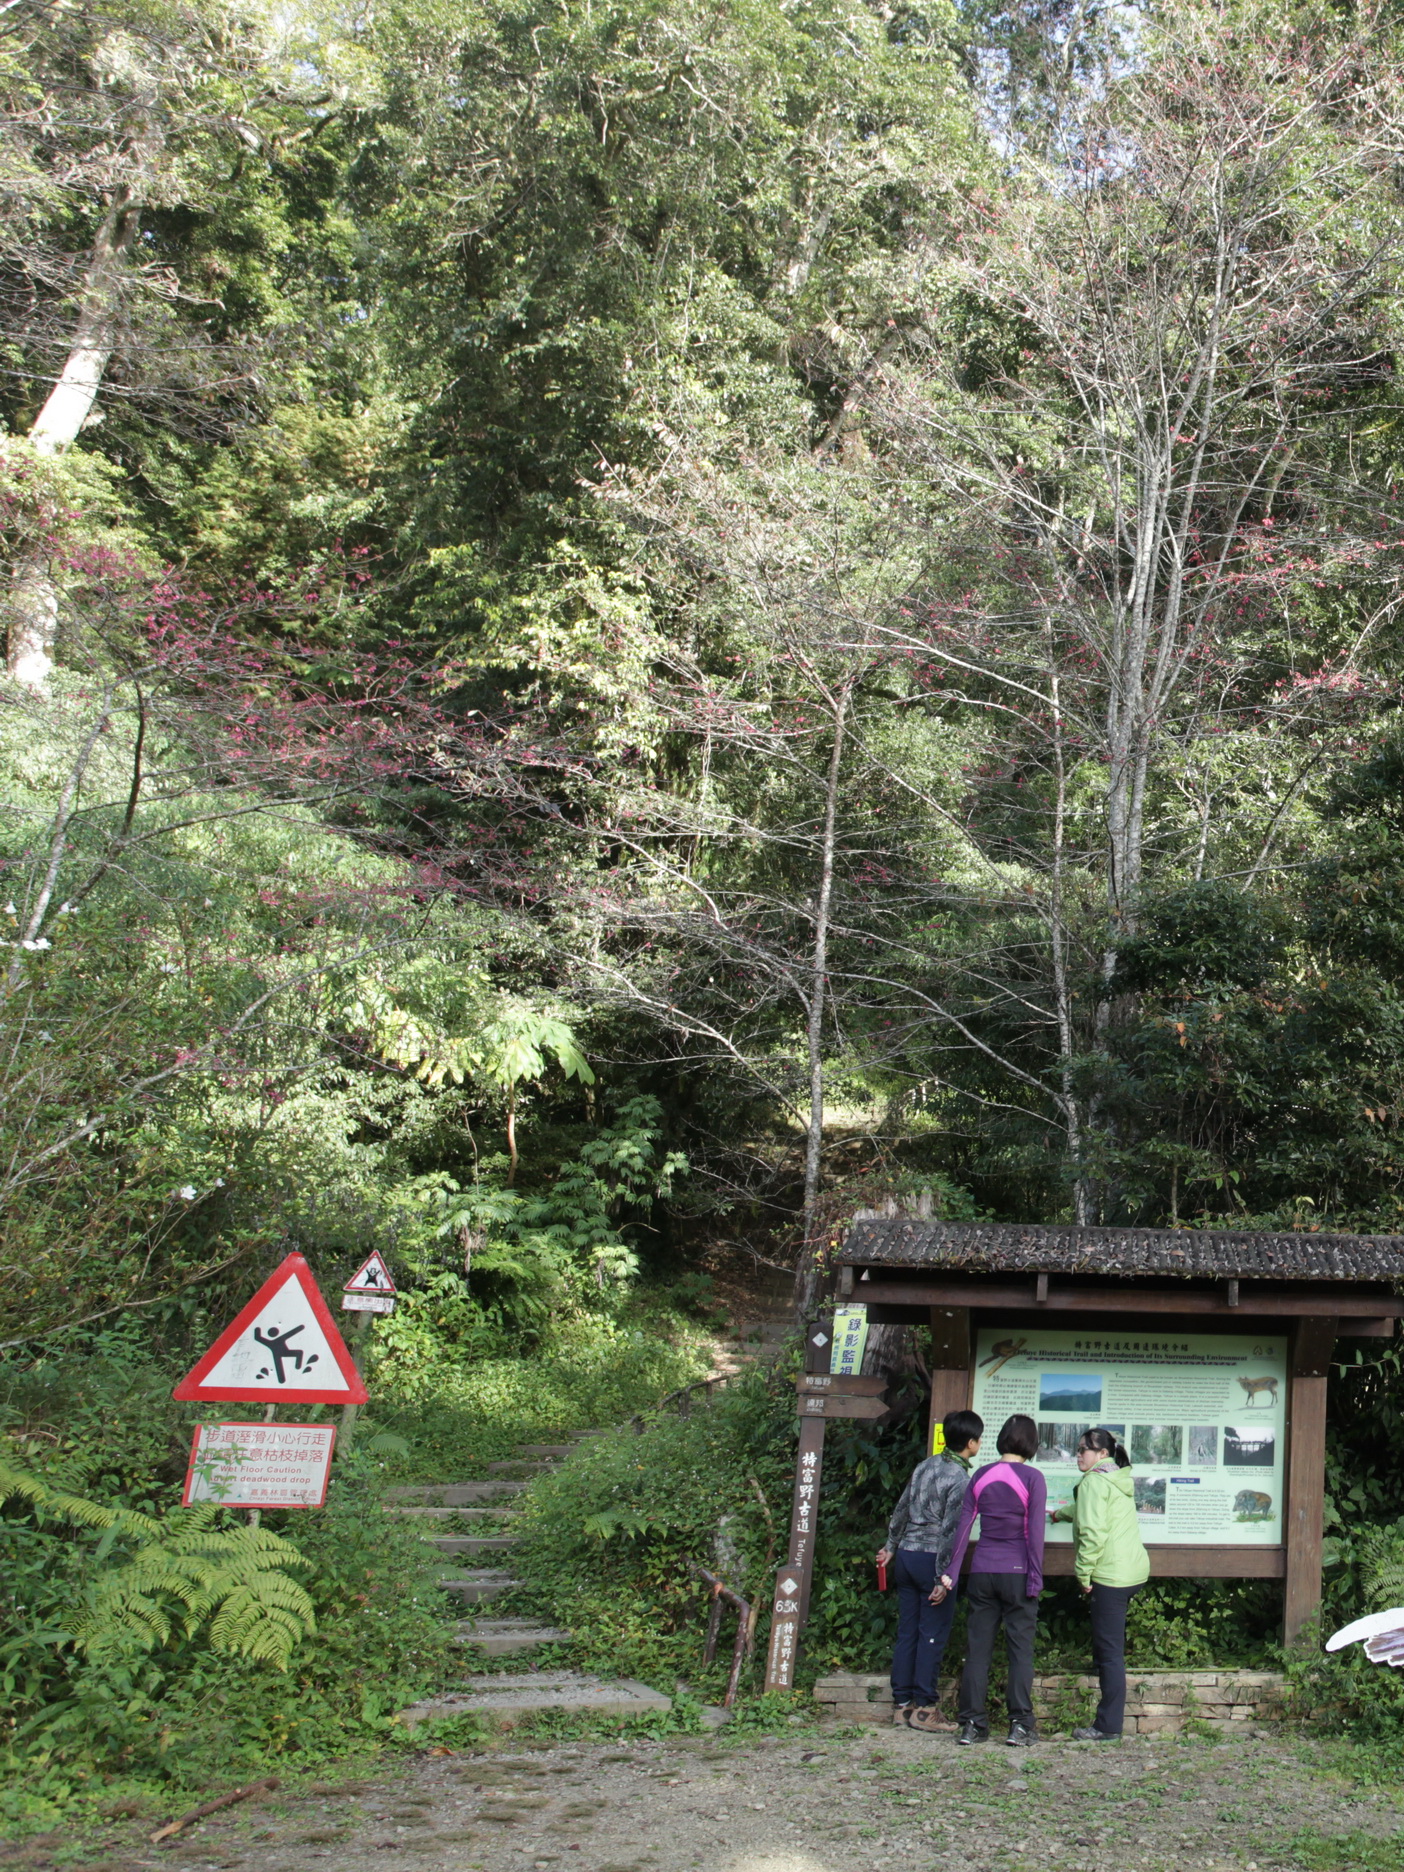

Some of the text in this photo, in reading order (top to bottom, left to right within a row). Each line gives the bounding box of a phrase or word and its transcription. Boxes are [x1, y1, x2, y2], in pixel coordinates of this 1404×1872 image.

[840, 1318, 862, 1375] 錄影監視
[206, 1429, 326, 1446] 步道溼滑小心行走
[240, 1465, 264, 1473] Floor
[266, 1466, 302, 1474] Caution
[240, 1475, 287, 1483] deadwood
[290, 1476, 311, 1484] drop
[796, 1451, 818, 1534] 特富野古道
[794, 1539, 806, 1567] Tefuye
[778, 1622, 794, 1686] 特富野古道
